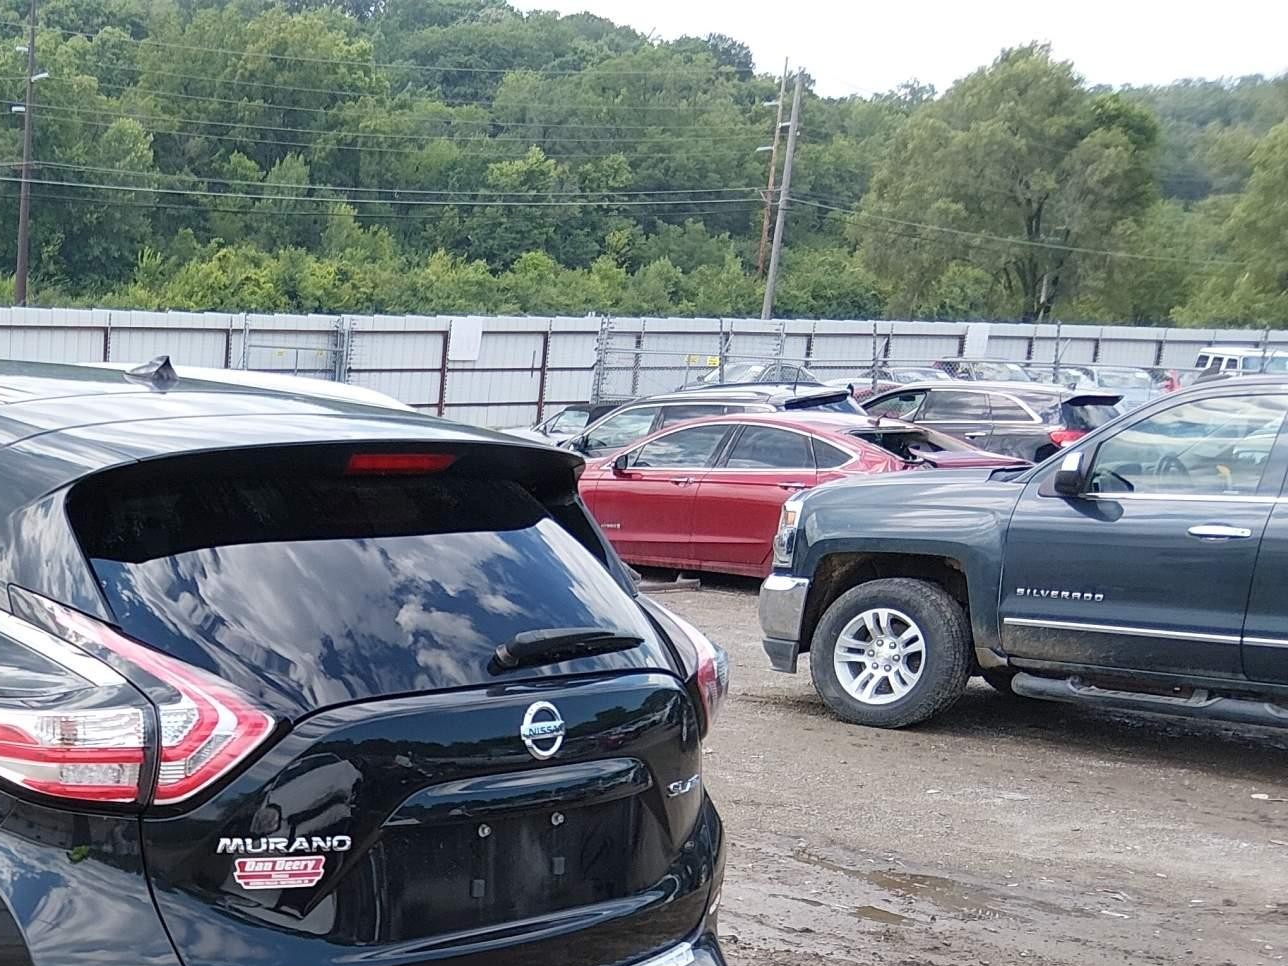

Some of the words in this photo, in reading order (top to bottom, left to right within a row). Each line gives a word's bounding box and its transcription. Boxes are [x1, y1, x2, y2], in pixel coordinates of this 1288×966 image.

[1015, 588, 1104, 602] SILVERADO
[216, 835, 352, 854] MURANO
[244, 860, 273, 871] Dan
[274, 859, 316, 871] Deery
